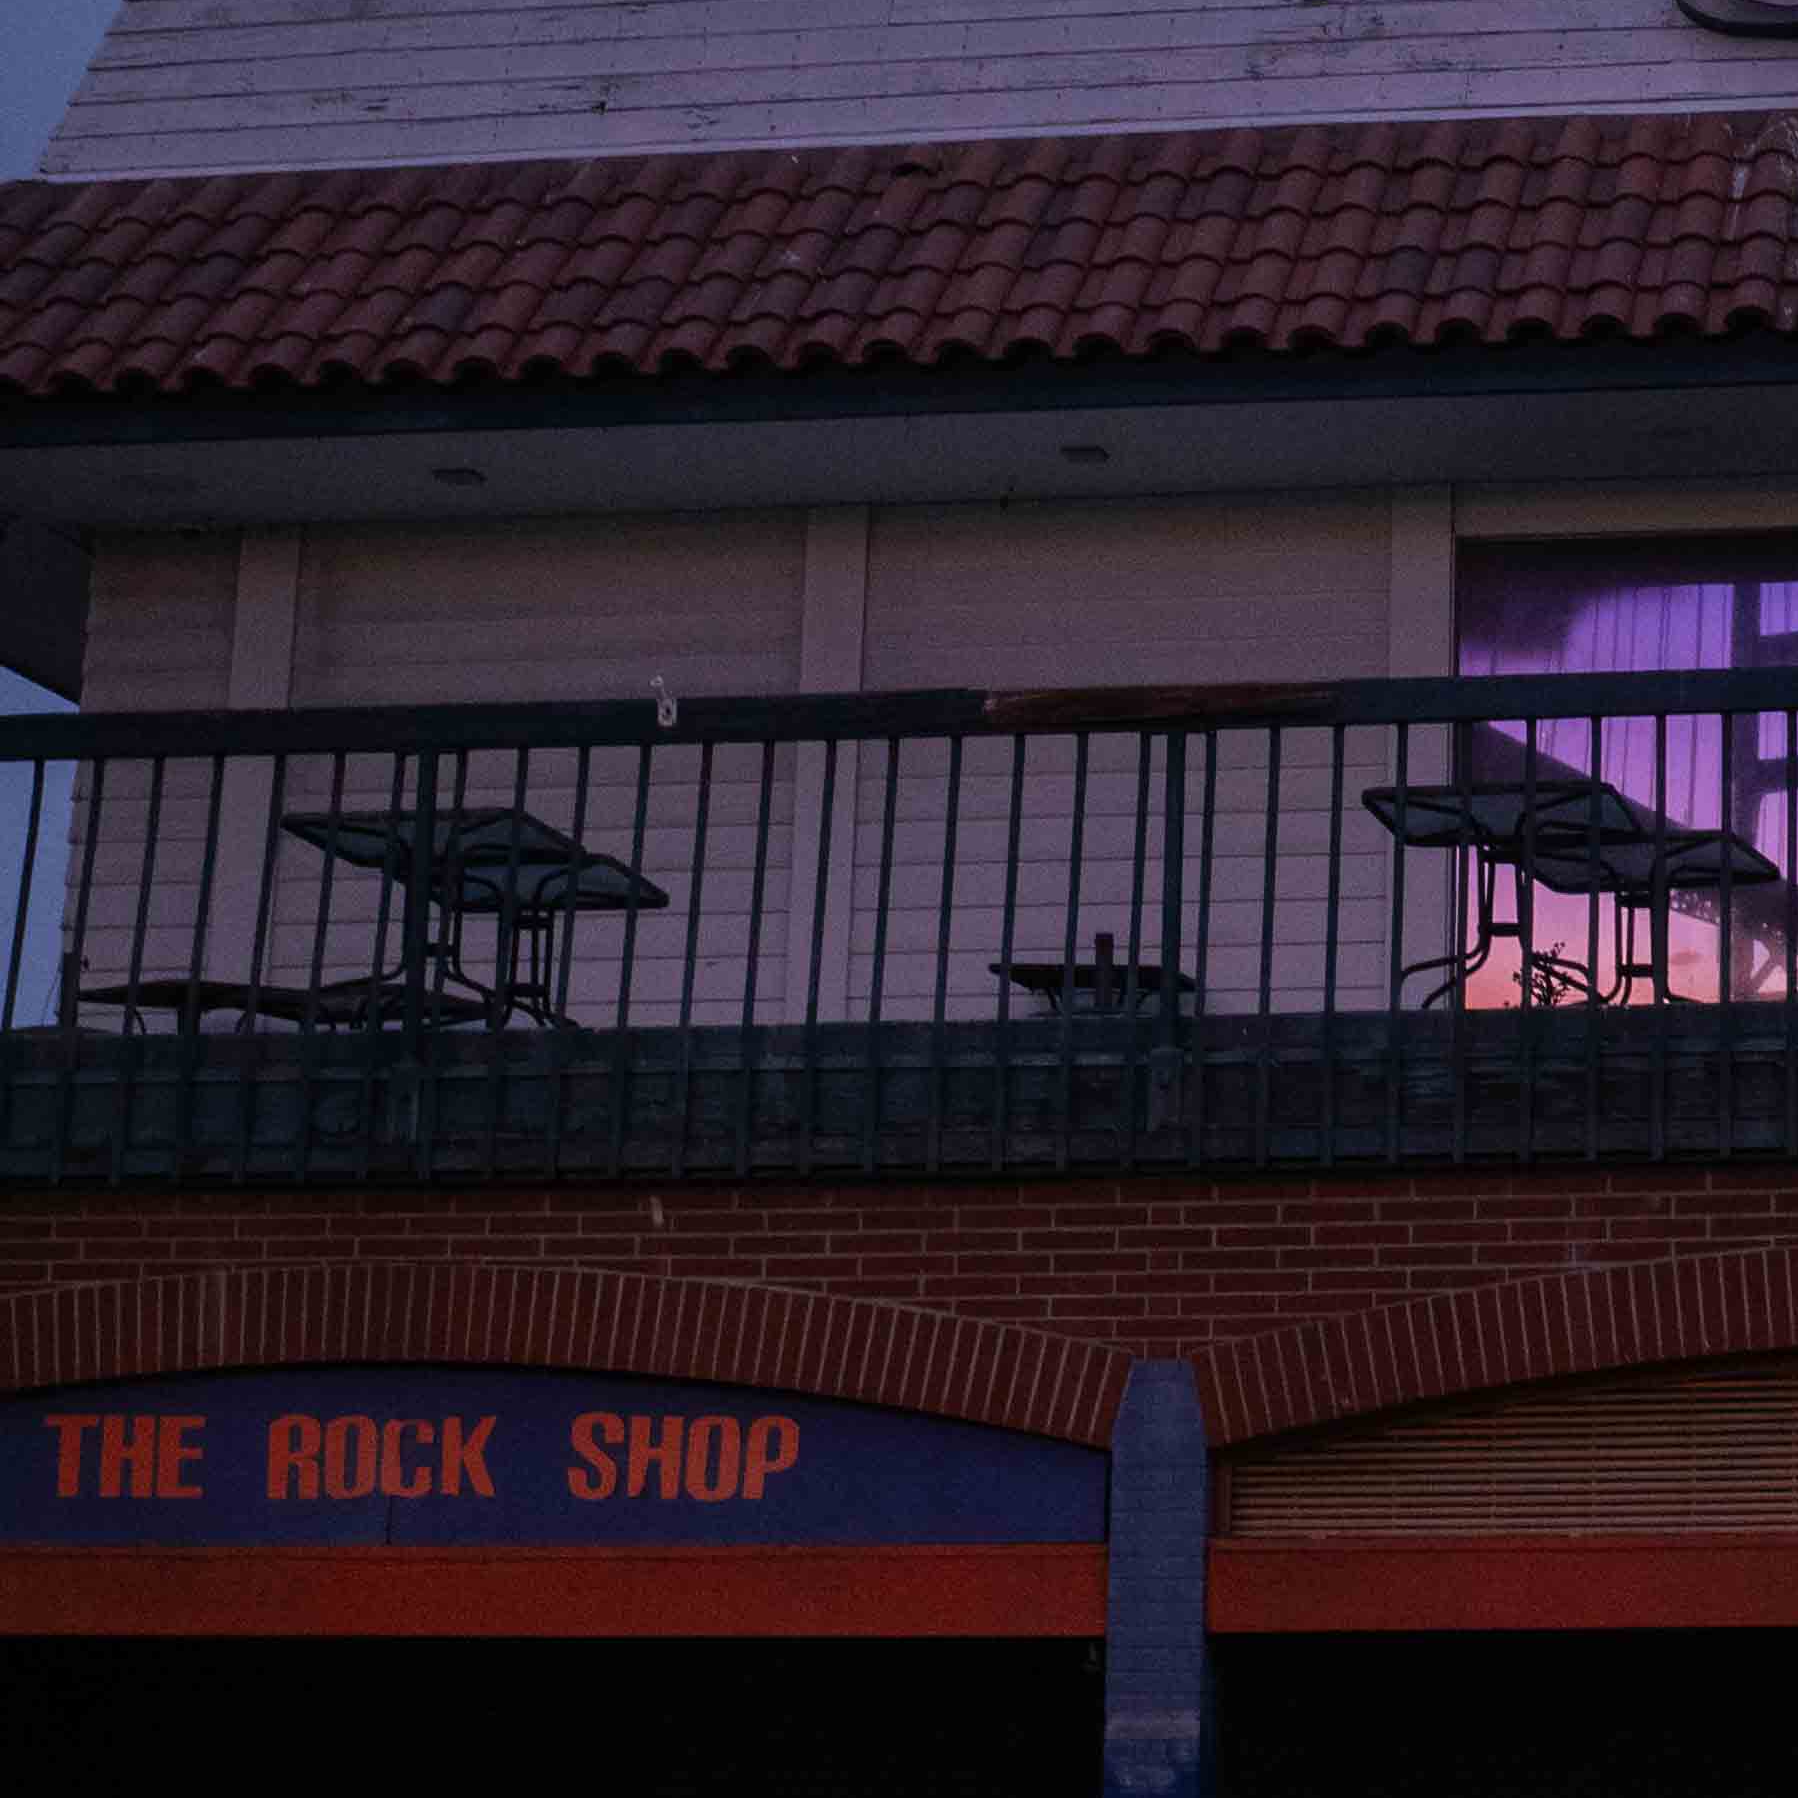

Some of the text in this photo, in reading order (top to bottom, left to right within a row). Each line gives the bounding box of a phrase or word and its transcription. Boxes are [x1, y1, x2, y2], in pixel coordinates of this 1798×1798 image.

[43, 1413, 800, 1501] THE ROCK SHOP
